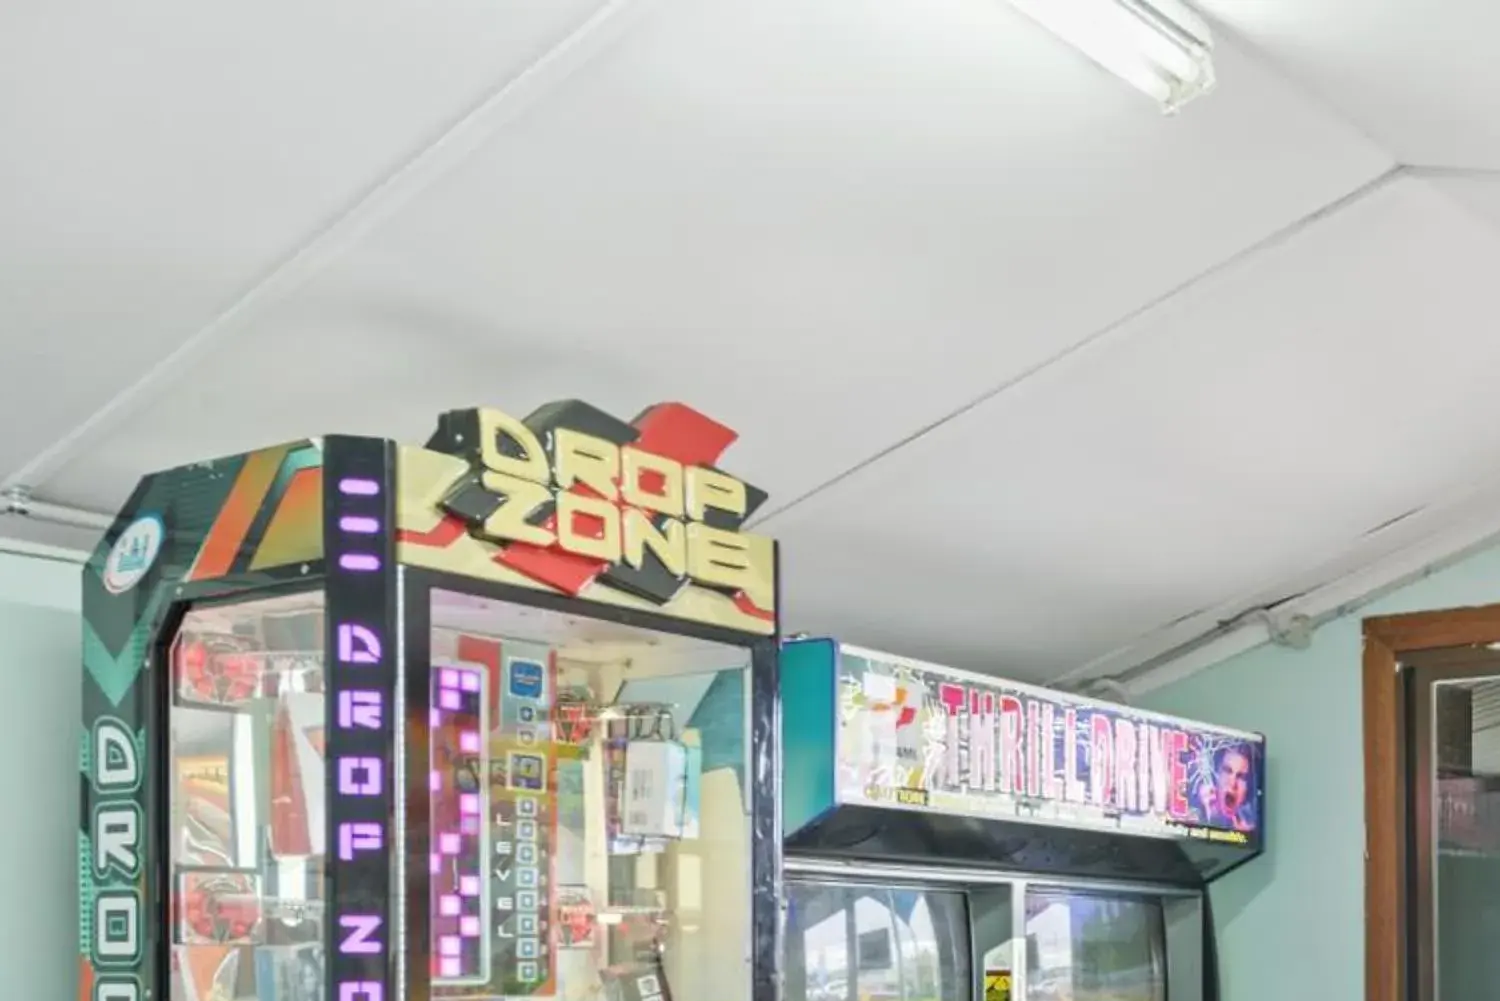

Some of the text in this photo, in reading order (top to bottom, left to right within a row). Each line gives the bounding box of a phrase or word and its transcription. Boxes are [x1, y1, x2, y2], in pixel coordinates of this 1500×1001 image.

[478, 406, 747, 522] DROP
[481, 469, 752, 588] ZONE
[337, 622, 383, 861] DROP
[939, 682, 1085, 806] THRILL
[1090, 712, 1189, 817] DRIVE
[496, 812, 514, 939] LEVEL
